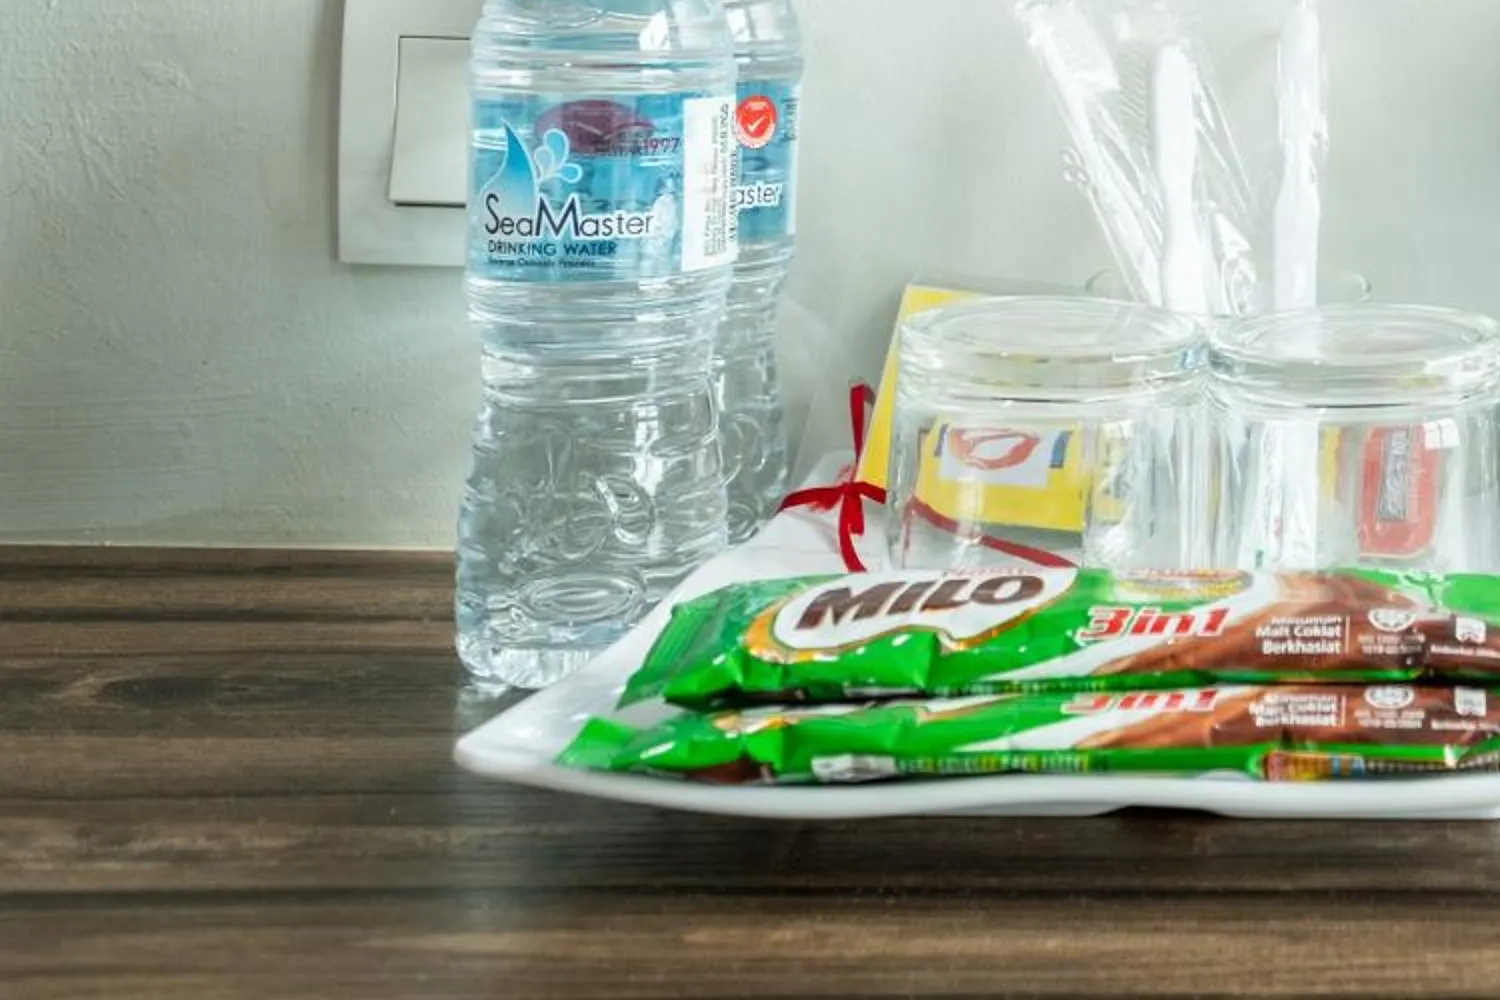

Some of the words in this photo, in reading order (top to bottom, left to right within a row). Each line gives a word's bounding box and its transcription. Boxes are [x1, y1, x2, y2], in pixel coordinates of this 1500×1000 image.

[737, 185, 781, 205] aster
[485, 193, 654, 238] SeaMaster
[488, 240, 558, 257] DRINKING
[562, 240, 618, 256] WATER
[794, 575, 1045, 631] MILO
[1076, 607, 1232, 643] 3in1
